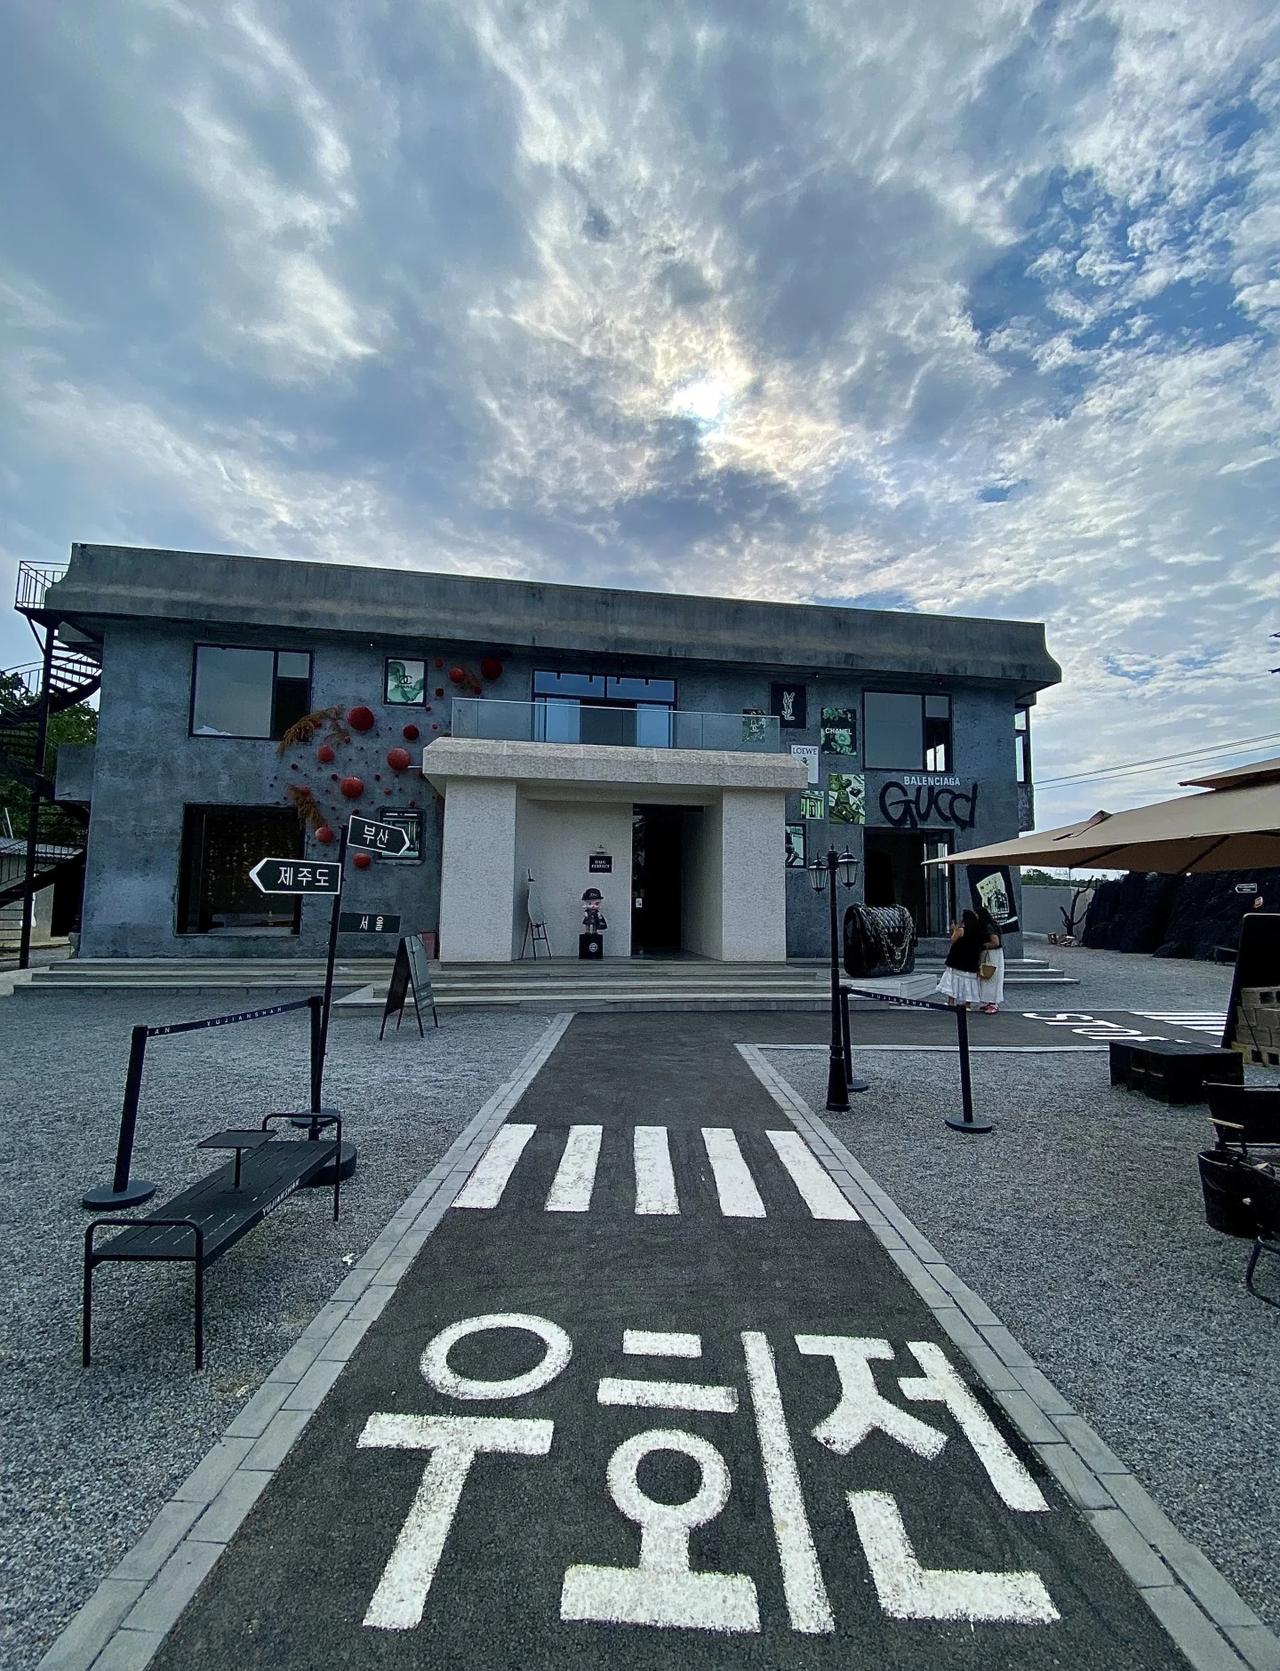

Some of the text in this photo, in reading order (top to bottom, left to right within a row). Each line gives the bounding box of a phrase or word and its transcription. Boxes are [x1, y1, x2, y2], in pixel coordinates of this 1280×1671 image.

[792, 746, 818, 756] LOEWE
[903, 775, 961, 786] BALENCIAGA
[362, 824, 389, 848] 부산
[277, 866, 330, 887] 제주도
[359, 915, 384, 931] 서울
[206, 1007, 282, 1027] YUJIANSHAN
[356, 1313, 1062, 1634] 우회전
